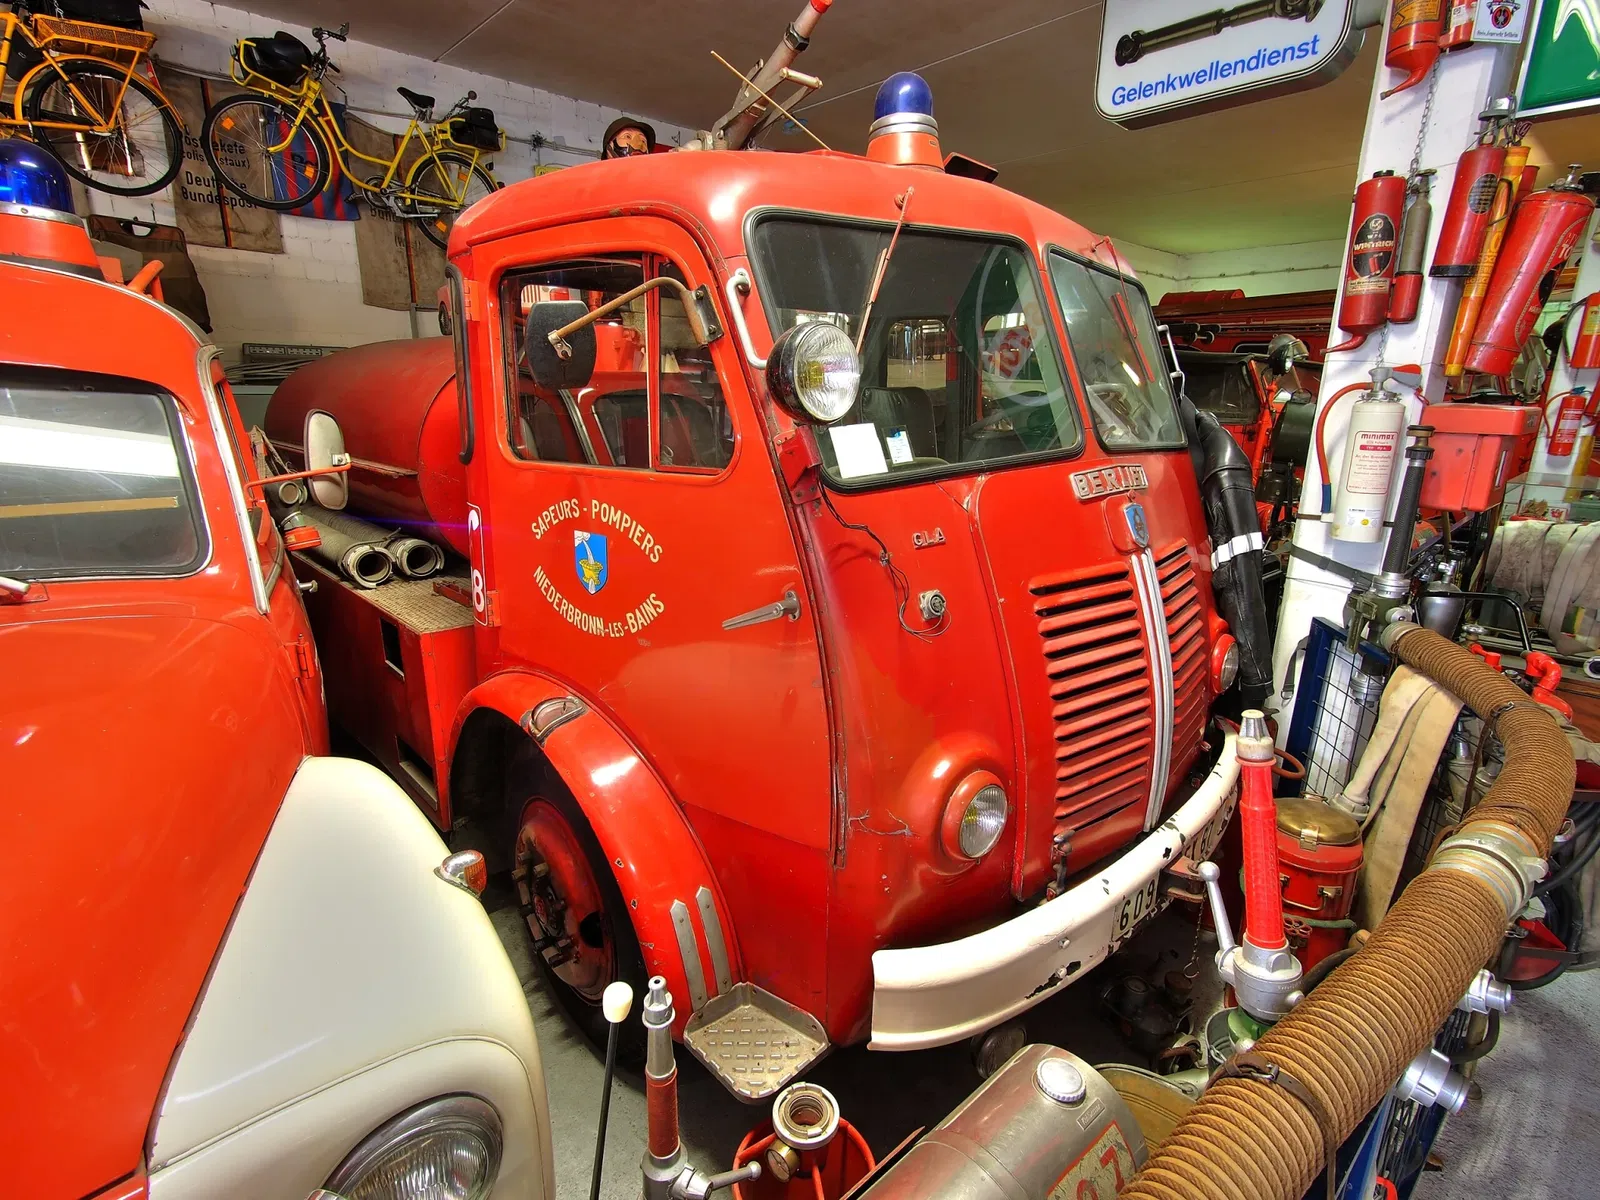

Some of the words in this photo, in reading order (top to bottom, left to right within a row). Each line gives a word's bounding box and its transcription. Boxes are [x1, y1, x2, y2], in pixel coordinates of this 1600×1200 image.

[1111, 34, 1320, 106] Gelenkwellendienst
[1360, 433, 1395, 441] minimax
[531, 498, 580, 540] SAPEURS
[591, 499, 663, 563] POMPIERS
[912, 527, 946, 549] GLA
[1119, 878, 1156, 932] 609
